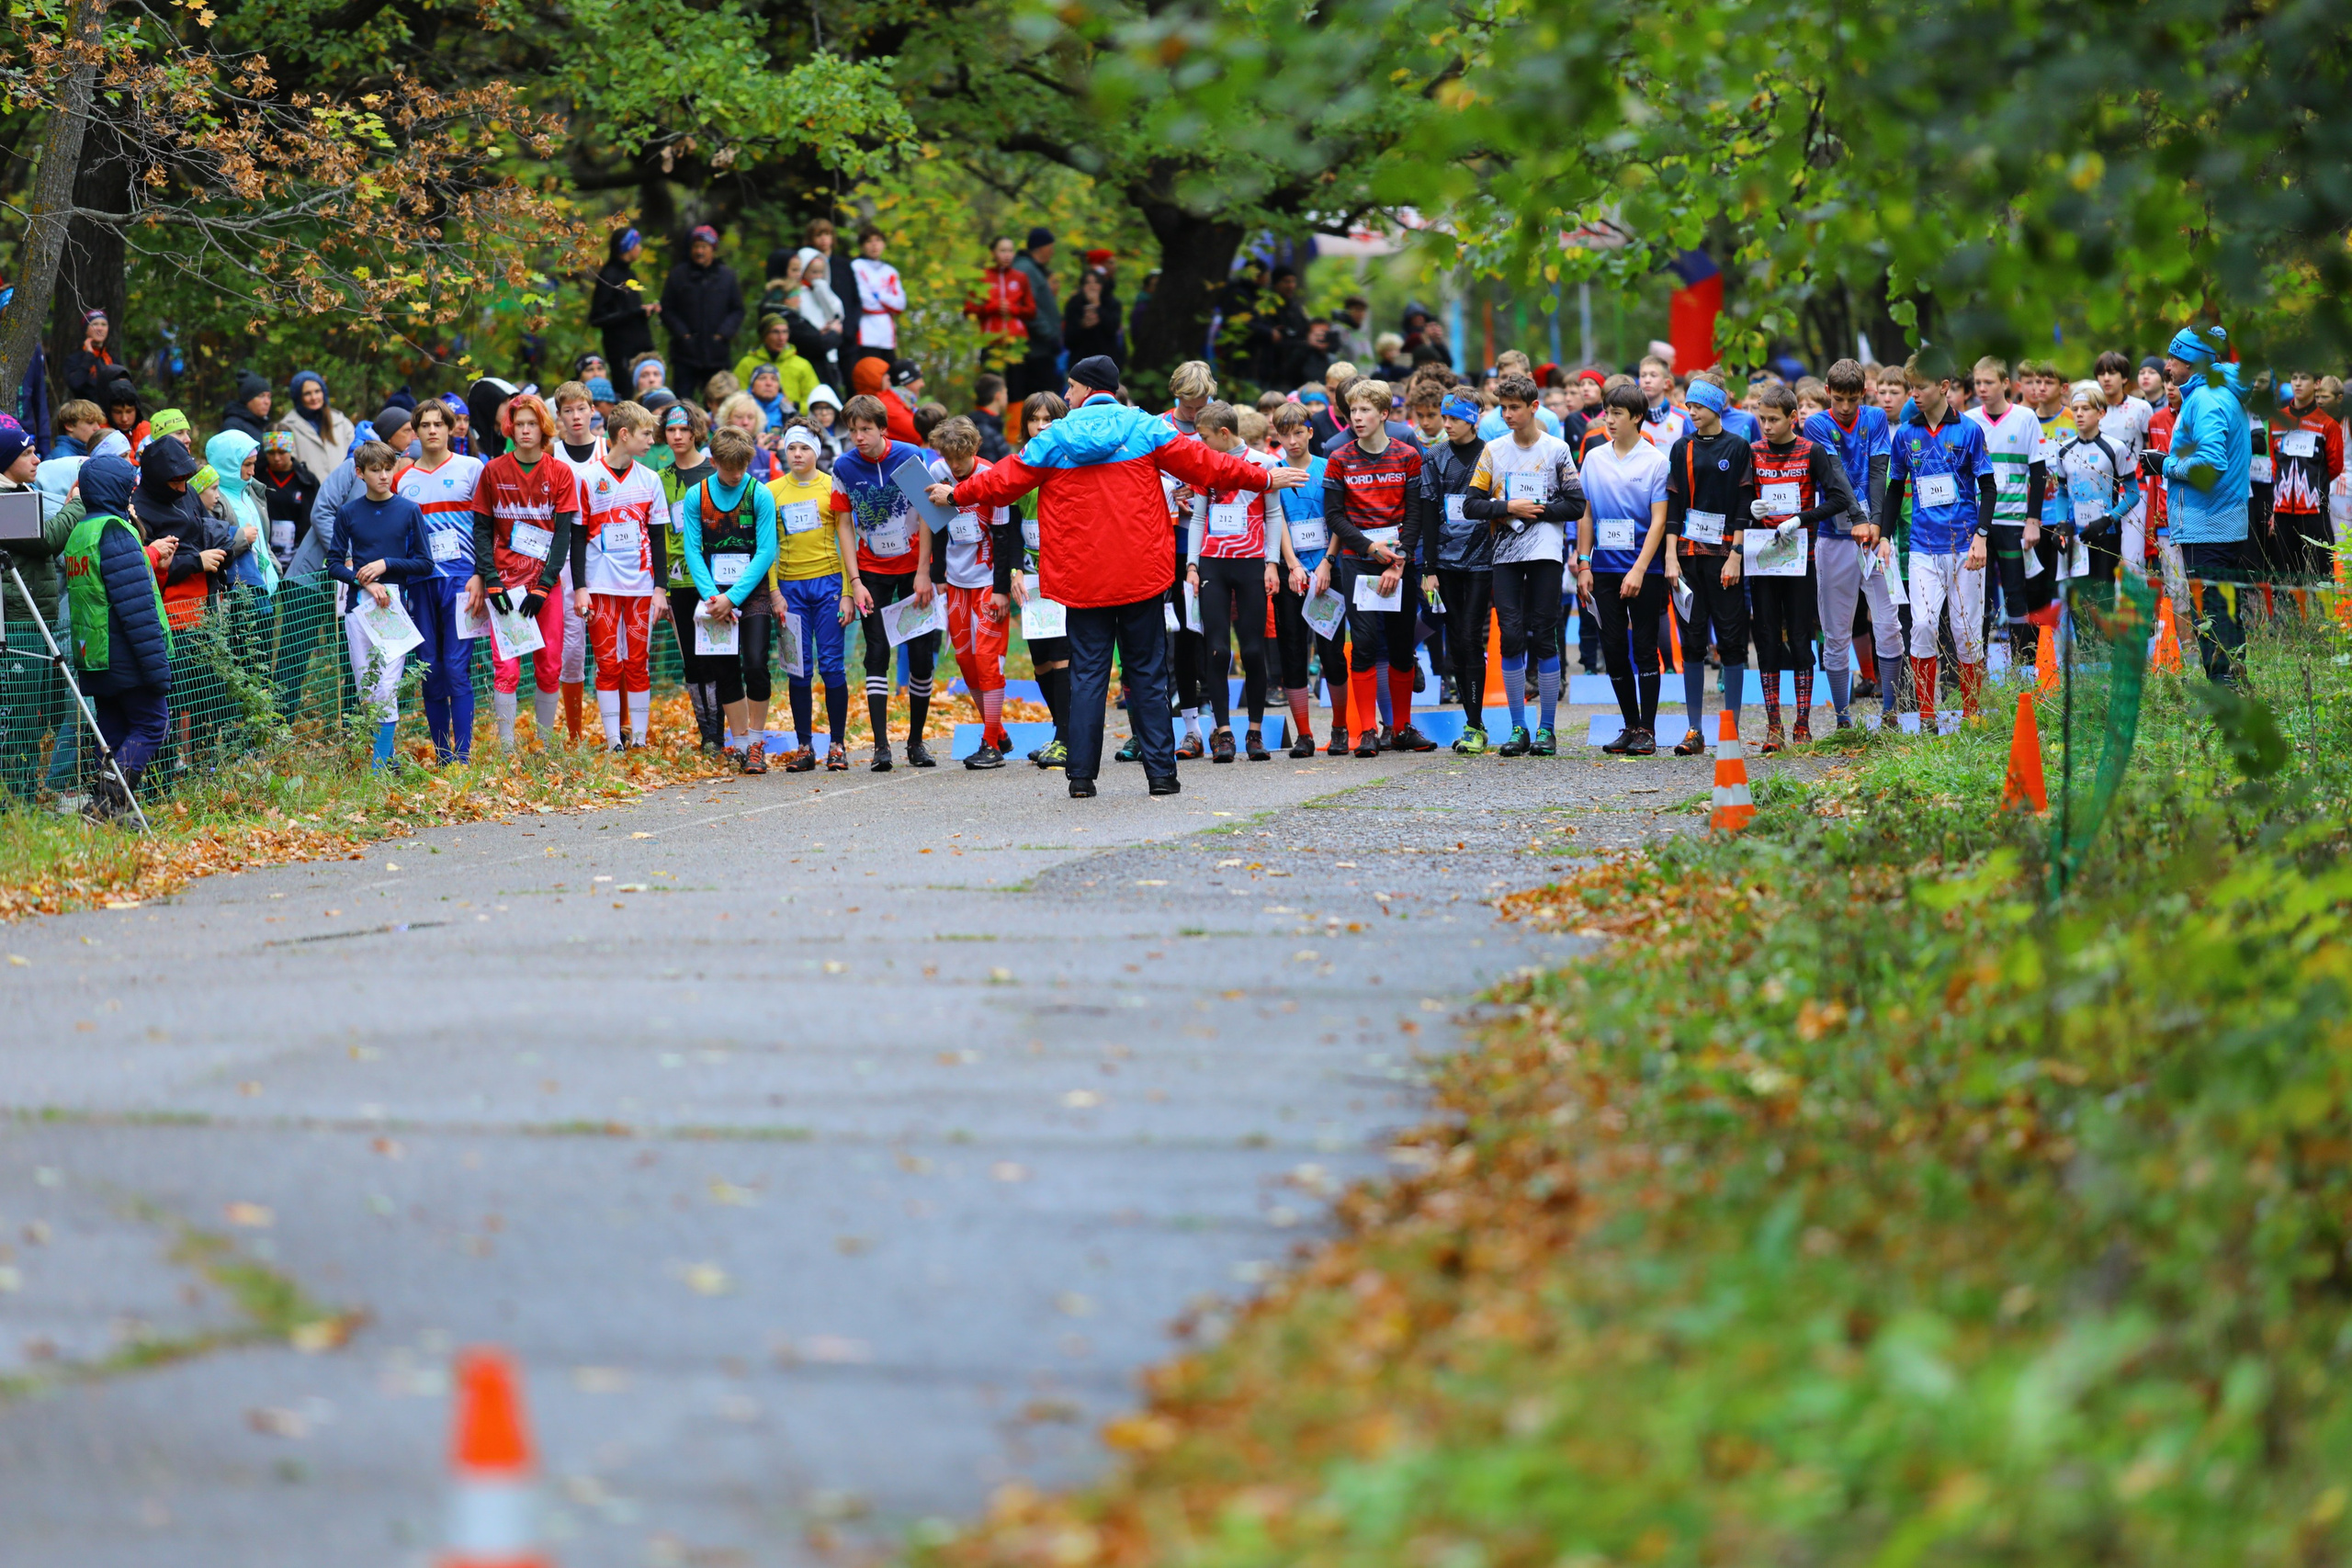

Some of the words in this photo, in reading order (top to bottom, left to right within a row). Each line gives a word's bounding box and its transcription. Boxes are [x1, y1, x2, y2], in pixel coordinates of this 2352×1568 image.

[1781, 468, 1807, 478] WEST
[1343, 474, 1374, 485] NORD
[1376, 472, 1407, 484] WEST
[1520, 484, 1534, 492] 206
[1930, 486, 1943, 495] 201
[1772, 493, 1787, 502] 203
[795, 514, 808, 523] 217
[1219, 514, 1233, 523] 212
[956, 525, 967, 535] 215
[1695, 523, 1709, 532] 204
[615, 533, 629, 542] 220
[1301, 531, 1316, 540] 209
[1607, 531, 1621, 539] 205
[523, 536, 537, 547] 222
[881, 541, 896, 549] 216
[431, 543, 446, 553] 223
[722, 567, 736, 575] 218
